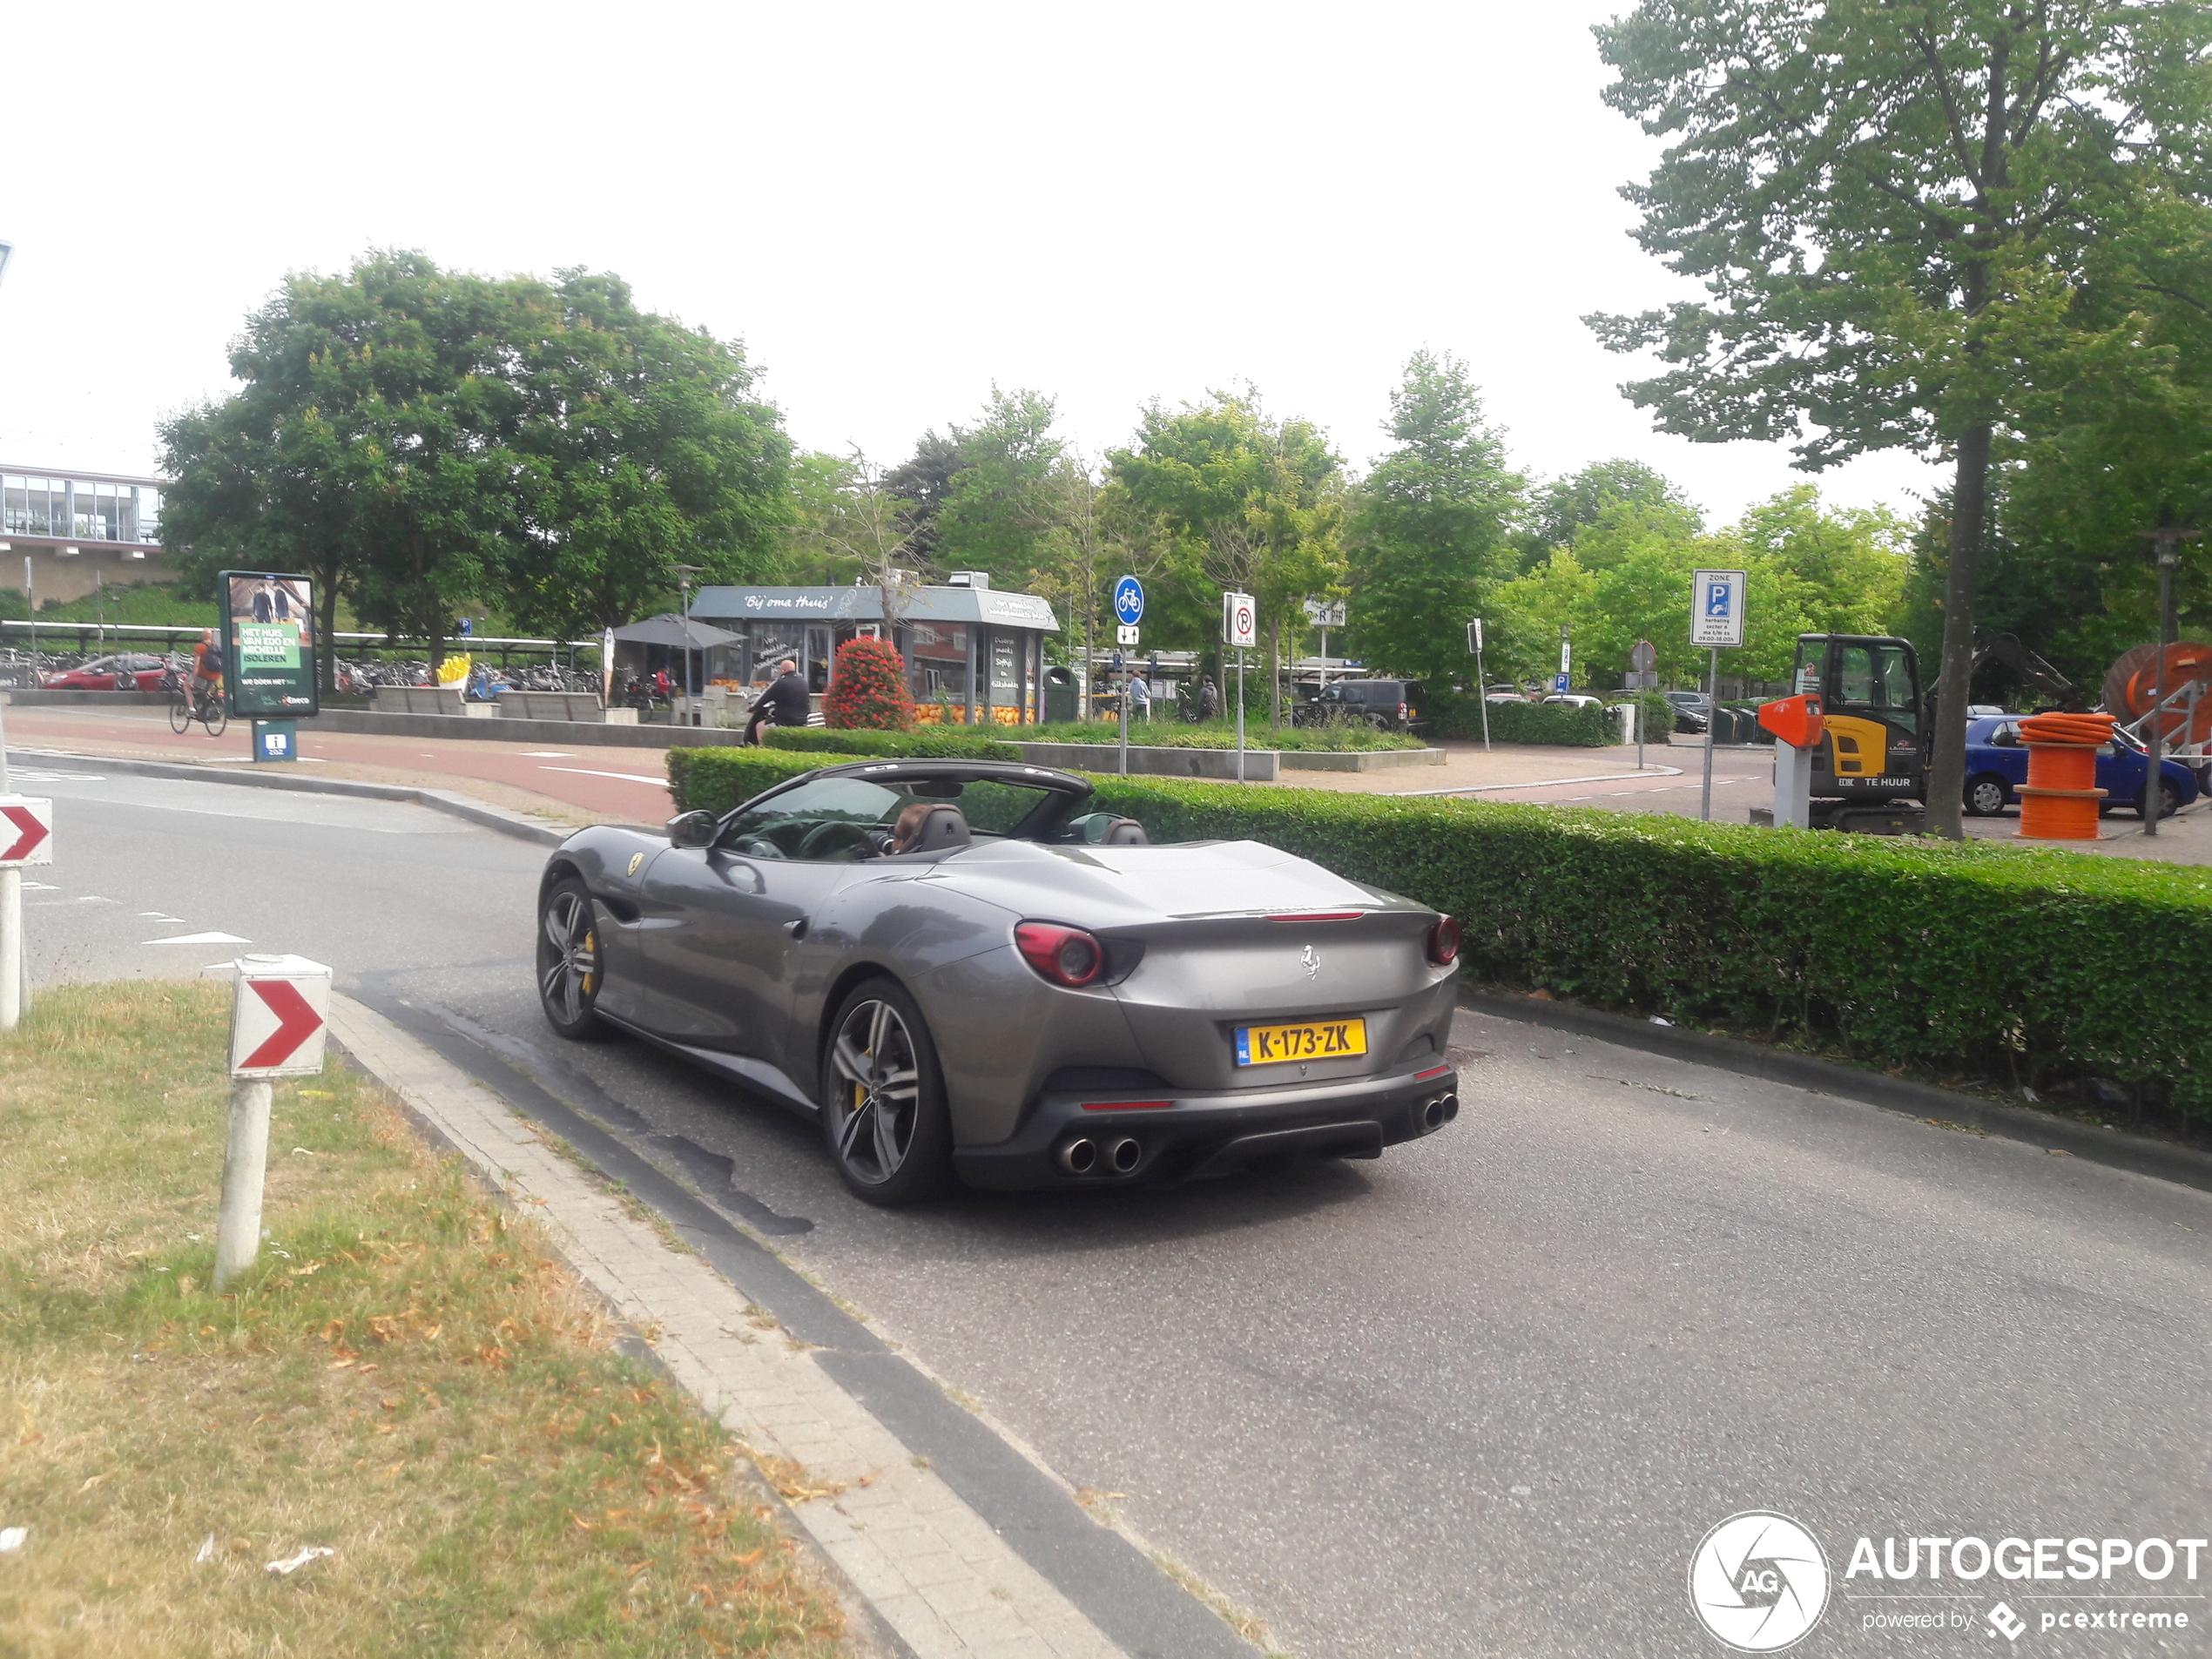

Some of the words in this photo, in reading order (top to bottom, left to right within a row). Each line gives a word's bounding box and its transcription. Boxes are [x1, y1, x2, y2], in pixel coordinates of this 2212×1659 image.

[1711, 585, 1726, 604] P
[766, 598, 792, 608] oma
[242, 628, 261, 637] HET
[261, 628, 283, 637] HUIS
[242, 637, 262, 645] VAN
[263, 637, 282, 646] EDO
[283, 637, 296, 646] EN
[242, 645, 286, 655] MICHELLE
[244, 654, 287, 663] ISOLEREN
[1557, 676, 1565, 686] P
[287, 696, 310, 705] Eneco
[1865, 778, 1878, 786] TE
[1881, 778, 1911, 787] HUUR
[1238, 1050, 1249, 1059] NL
[1258, 1025, 1351, 1058] K-173-ZK
